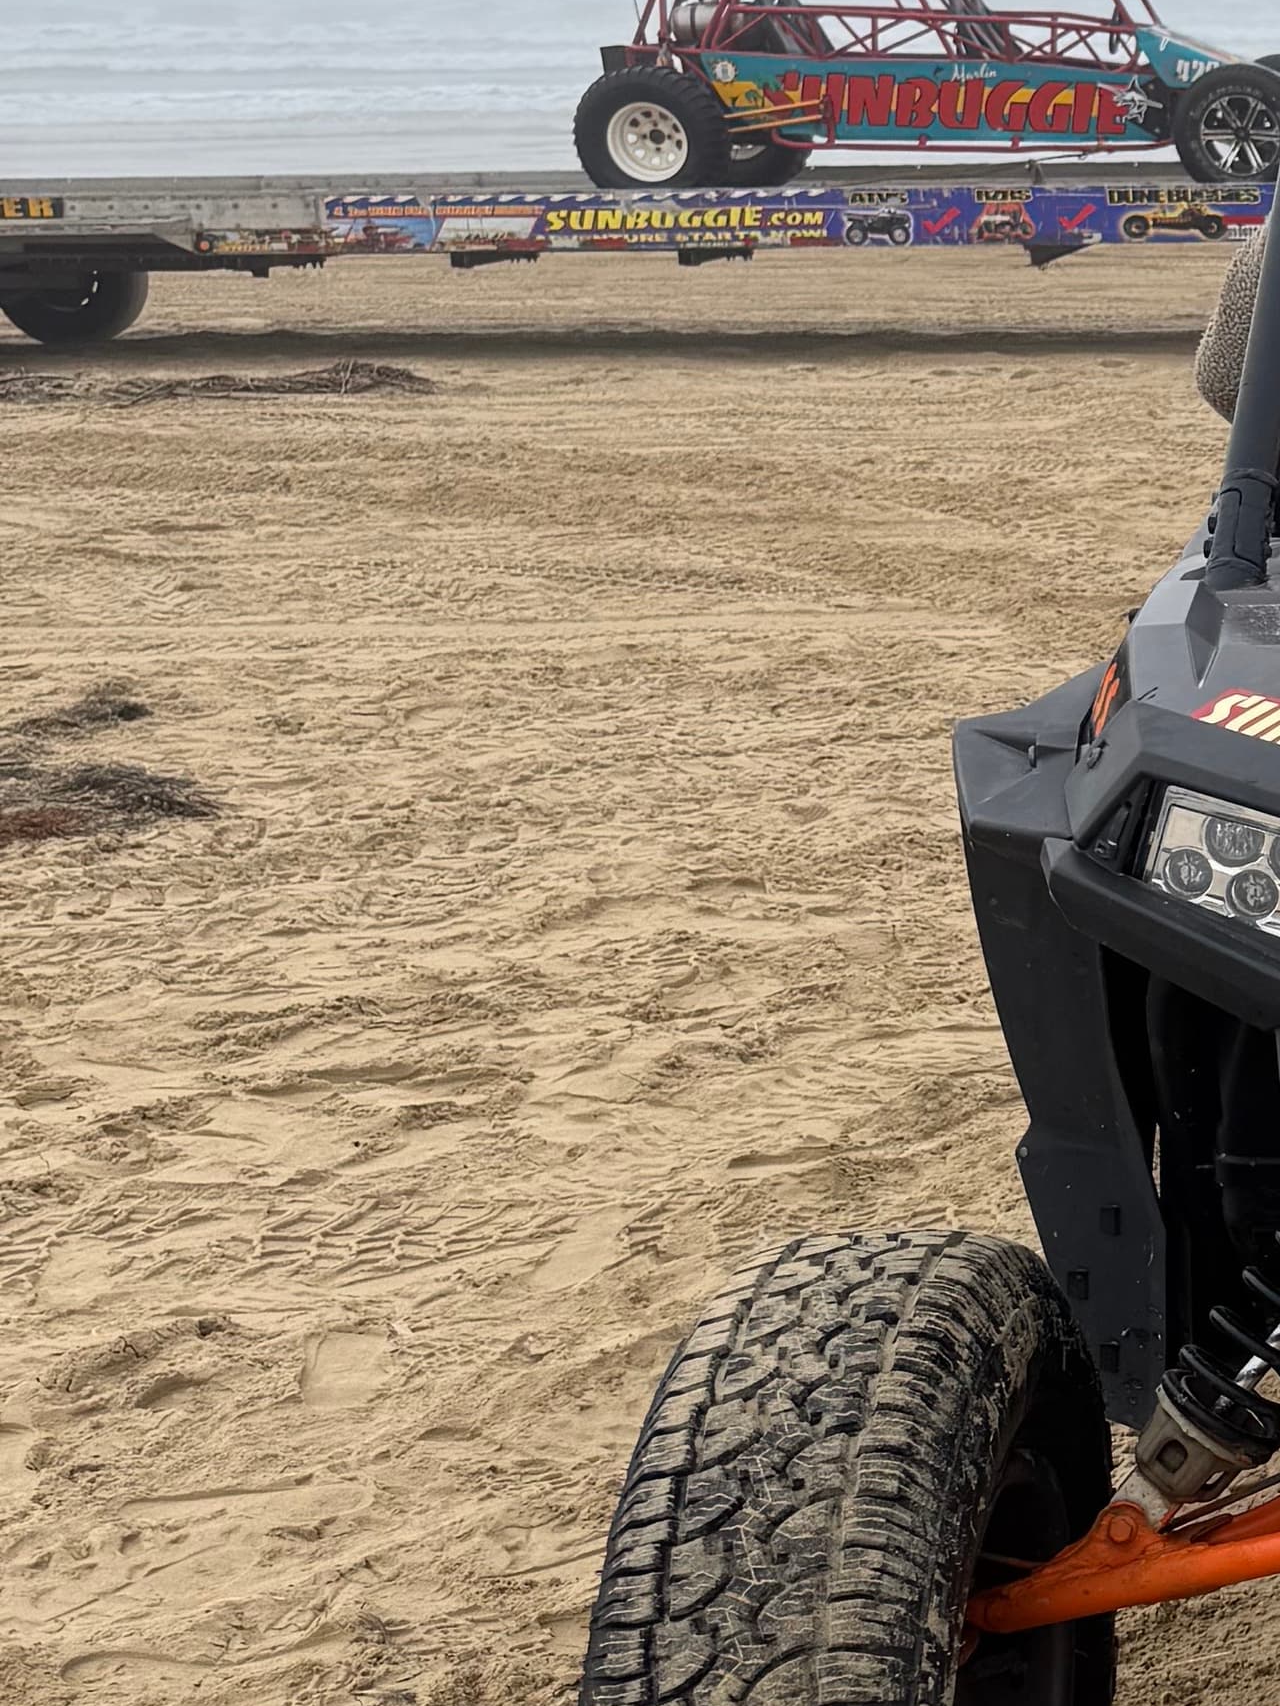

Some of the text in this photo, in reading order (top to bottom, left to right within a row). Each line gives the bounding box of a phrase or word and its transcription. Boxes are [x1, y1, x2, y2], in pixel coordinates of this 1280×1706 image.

[950, 63, 998, 82] Marlin
[1107, 189, 1166, 204] DUNE
[0, 197, 54, 218] ER
